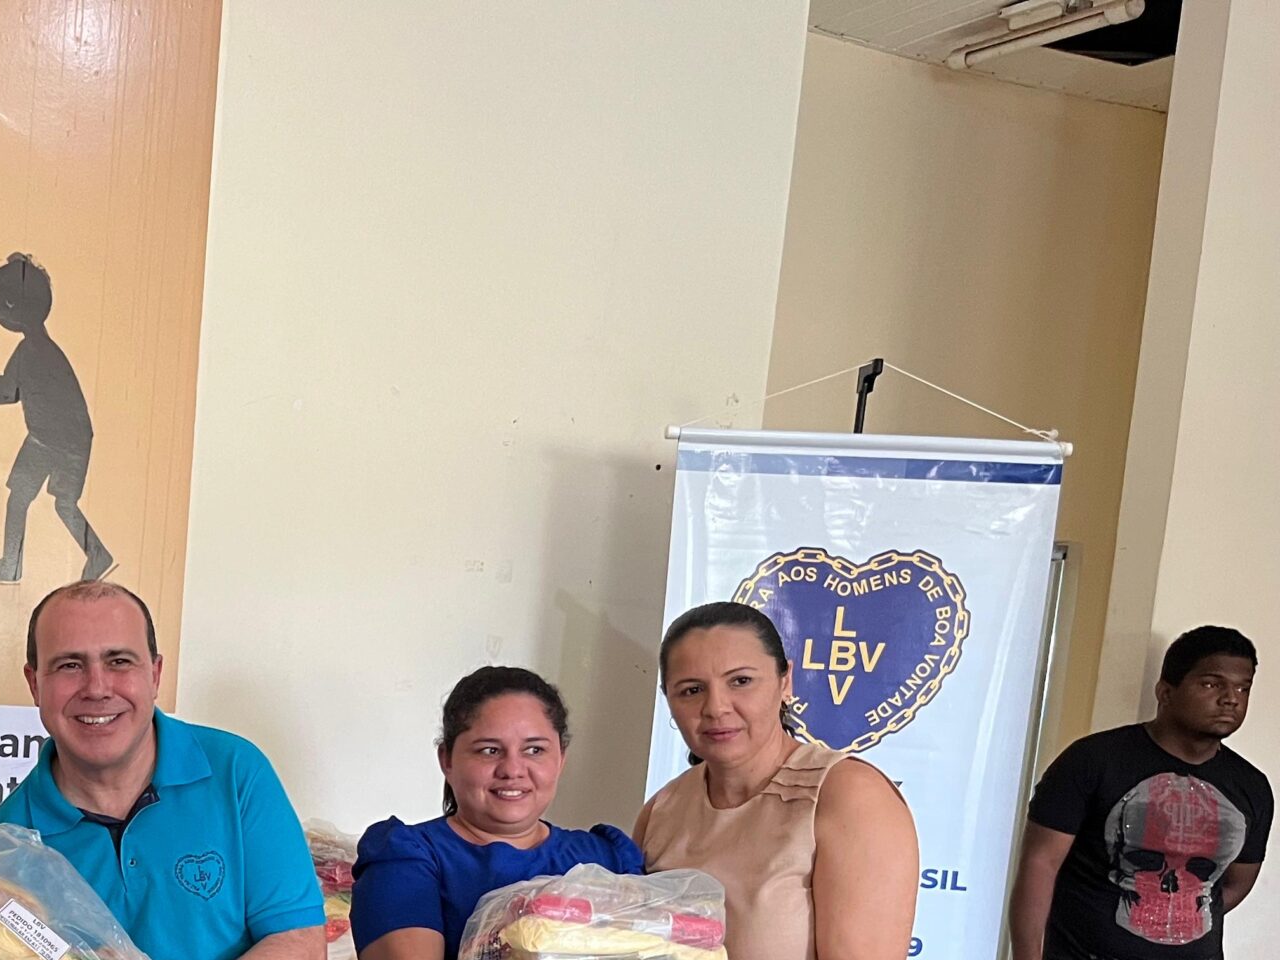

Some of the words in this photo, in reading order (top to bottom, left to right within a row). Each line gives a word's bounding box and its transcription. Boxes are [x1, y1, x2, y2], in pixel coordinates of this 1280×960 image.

[777, 566, 818, 587] AOS
[824, 569, 912, 596] HOMENS
[918, 575, 944, 602] DE
[929, 606, 952, 647] BOA
[801, 638, 886, 673] LBV
[864, 653, 940, 727] VONTADE
[8, 909, 34, 931] PEDIDO
[32, 918, 46, 930] LBV
